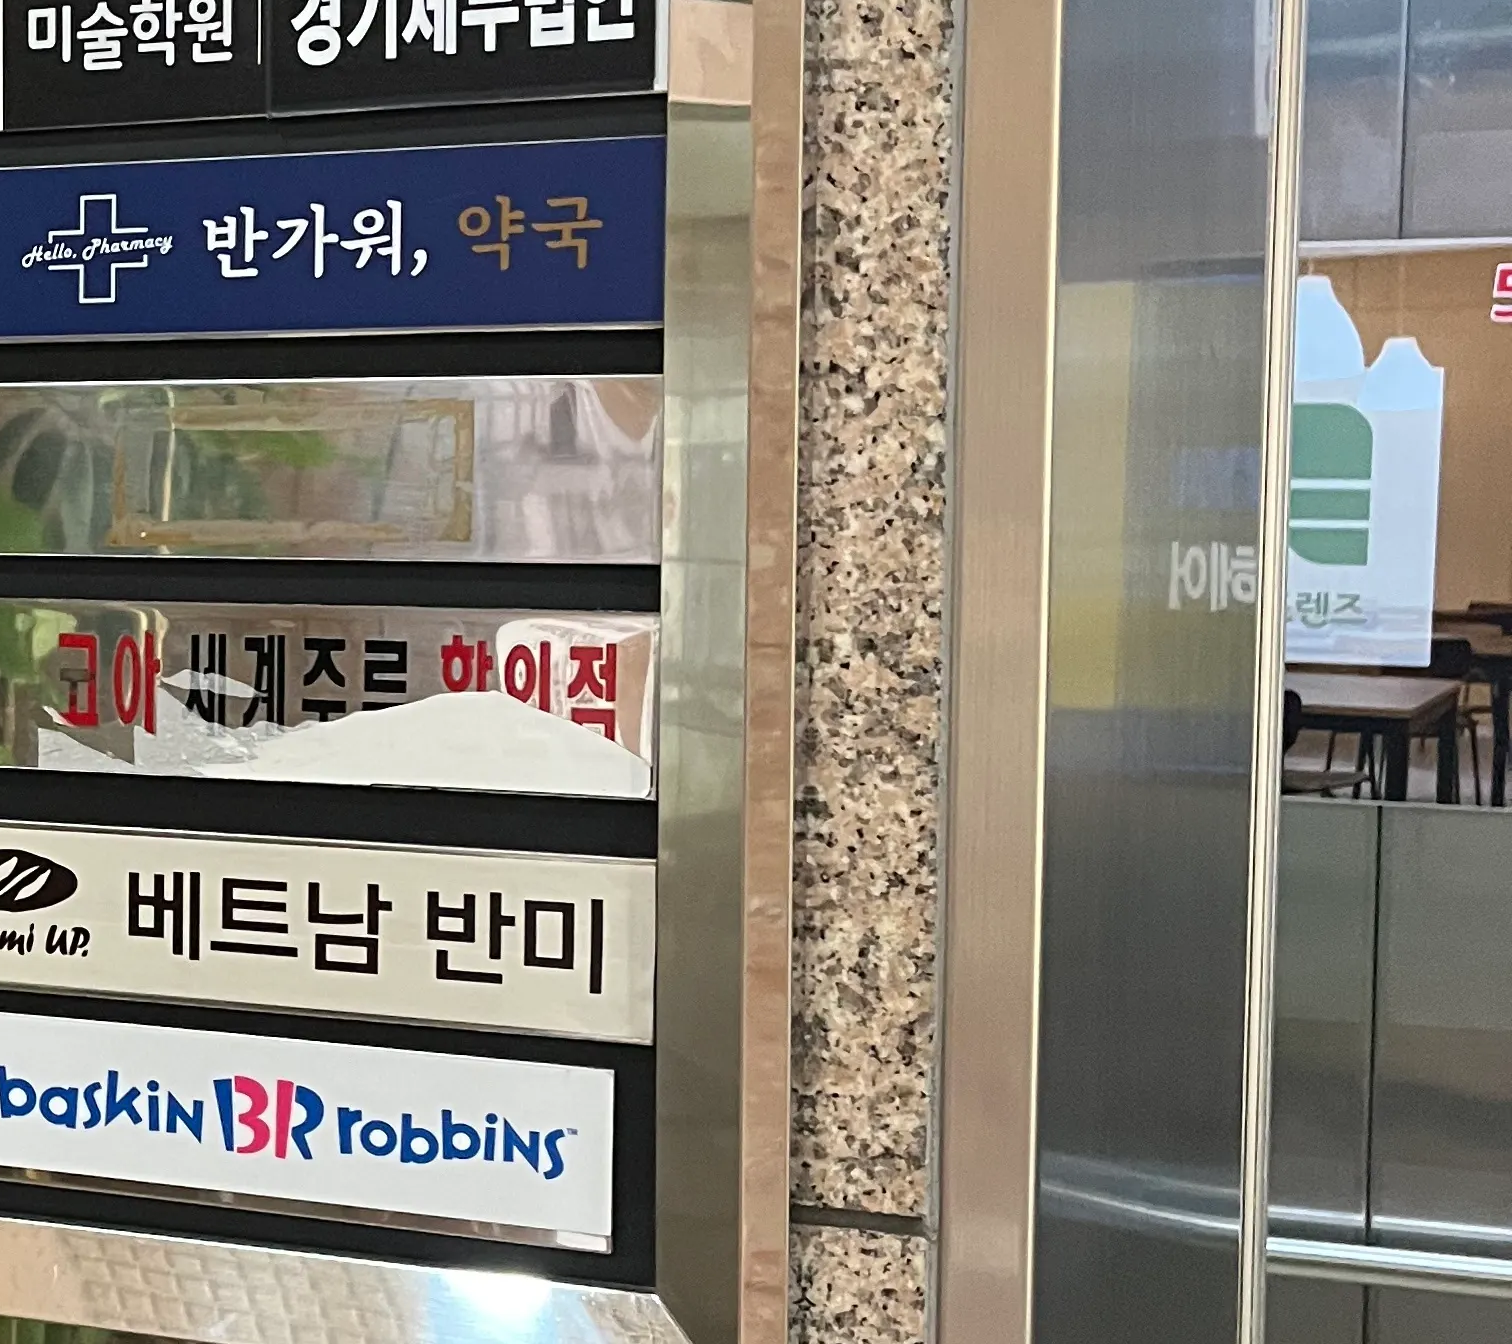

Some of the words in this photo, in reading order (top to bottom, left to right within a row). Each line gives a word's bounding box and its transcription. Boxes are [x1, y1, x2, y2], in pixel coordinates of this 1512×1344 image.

[82, 233, 174, 261] Pharmacy
[202, 199, 429, 279] 반가워,
[457, 195, 604, 271] 약국
[127, 870, 392, 975] 베트남
[426, 891, 604, 995] 반미
[213, 1075, 325, 1160] BR
